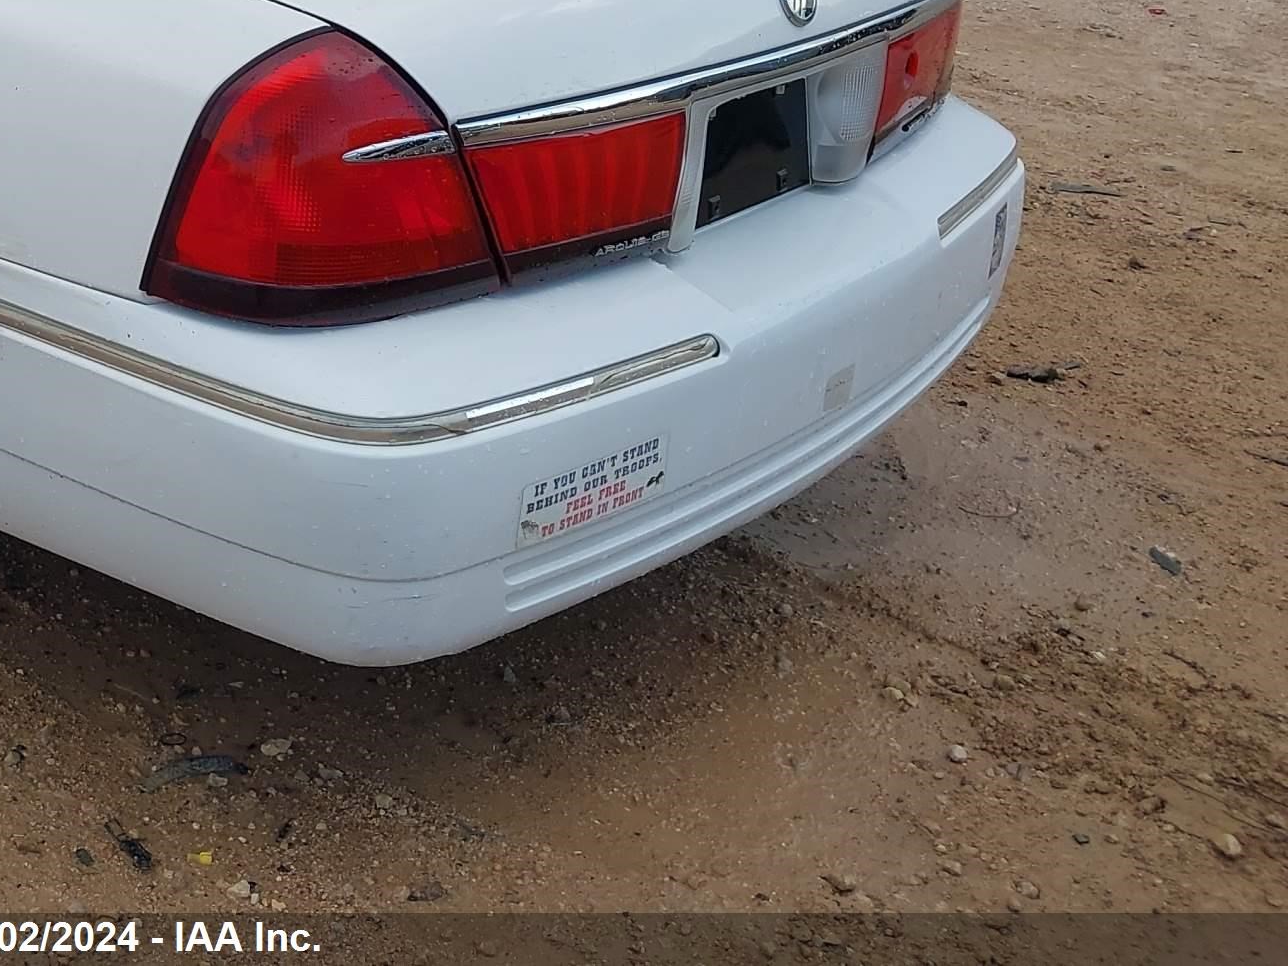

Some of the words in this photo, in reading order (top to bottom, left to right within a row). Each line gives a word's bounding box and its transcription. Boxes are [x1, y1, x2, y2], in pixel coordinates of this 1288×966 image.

[534, 482, 547, 497] IF
[553, 471, 576, 490] YOU
[581, 455, 617, 479] CAN'T
[622, 438, 659, 462] STAND
[527, 487, 577, 514] BEHIND
[584, 475, 607, 492] OUR
[541, 523, 555, 537] TO
[559, 509, 593, 530] STAND
[597, 502, 609, 515] IN
[612, 486, 644, 509] FRONT
[565, 494, 593, 514] FEEL
[598, 480, 626, 501] FREE
